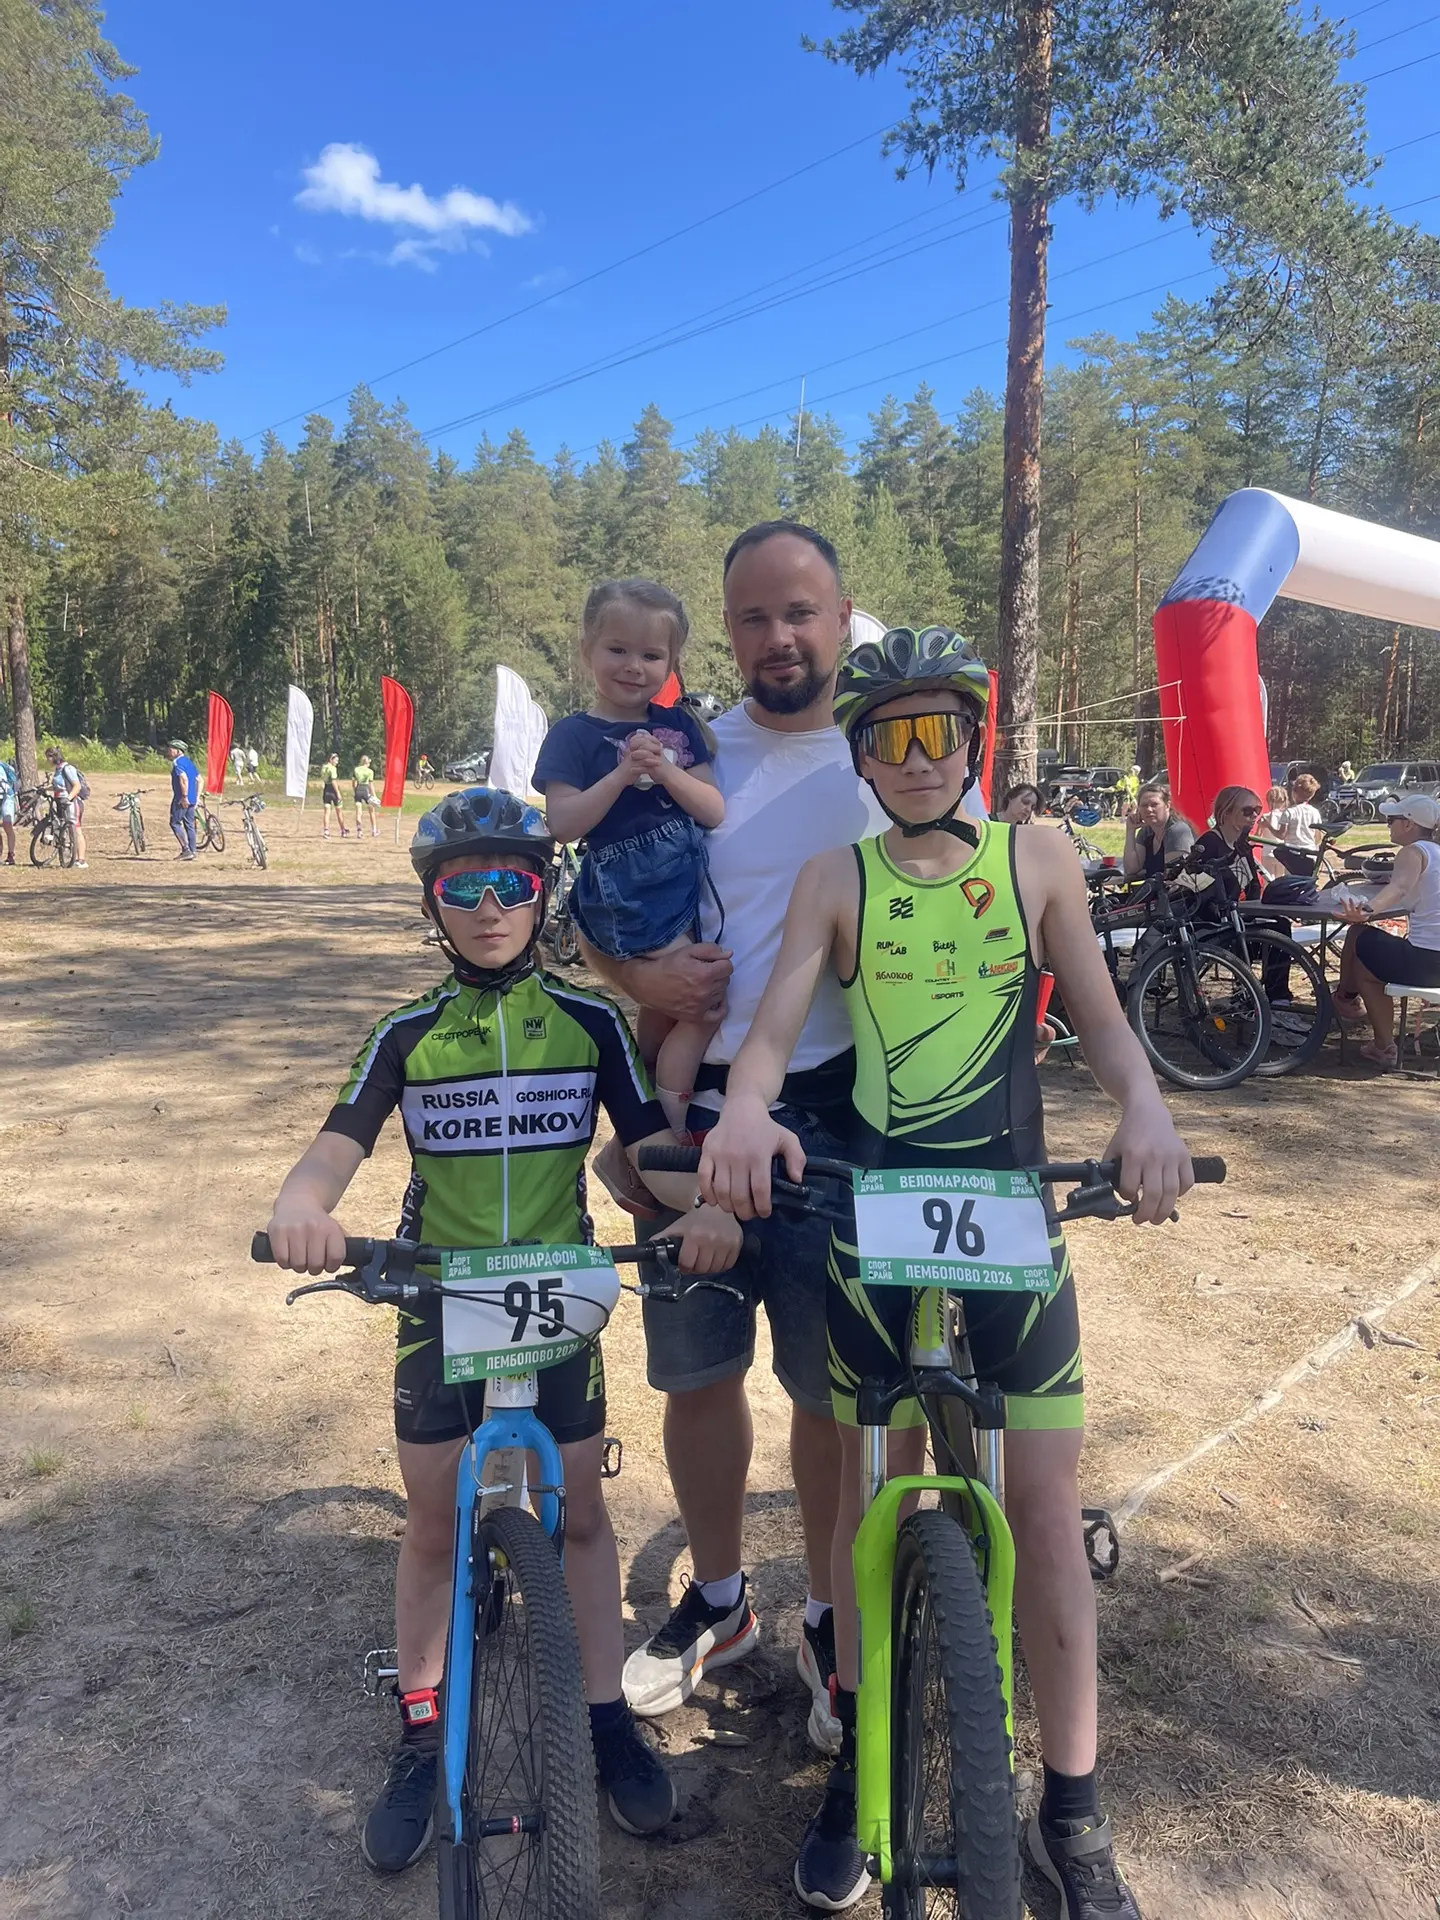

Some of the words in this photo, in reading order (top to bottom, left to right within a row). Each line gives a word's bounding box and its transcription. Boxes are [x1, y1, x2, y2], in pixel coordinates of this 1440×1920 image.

[876, 940, 895, 950] RUN
[890, 946, 907, 955] LAB
[931, 991, 964, 1000] USPORTS
[421, 1088, 500, 1110] RUSSIA
[899, 1174, 996, 1192] ВЕЛОМАРАФОН
[1010, 1176, 1034, 1186] СПОР
[860, 1183, 885, 1193] ДРАЙВ
[1011, 1184, 1035, 1196] ДРАЙВ
[922, 1197, 986, 1257] 96
[486, 1250, 578, 1272] ВЕЛОМАРАФОН
[867, 1260, 892, 1270] СПОРТ
[448, 1265, 472, 1278] ДРАЙВ
[905, 1264, 980, 1283] ЛЕМБОЛОВО
[983, 1269, 1013, 1285] 2026
[1023, 1268, 1048, 1279] СПОРТ
[1025, 1277, 1050, 1287] ДРАЙВ
[504, 1277, 565, 1343] 95
[451, 1356, 474, 1367] СПОРТ
[486, 1348, 554, 1371] ЛЕМБОЛОВО
[415, 1708, 430, 1717] 095
